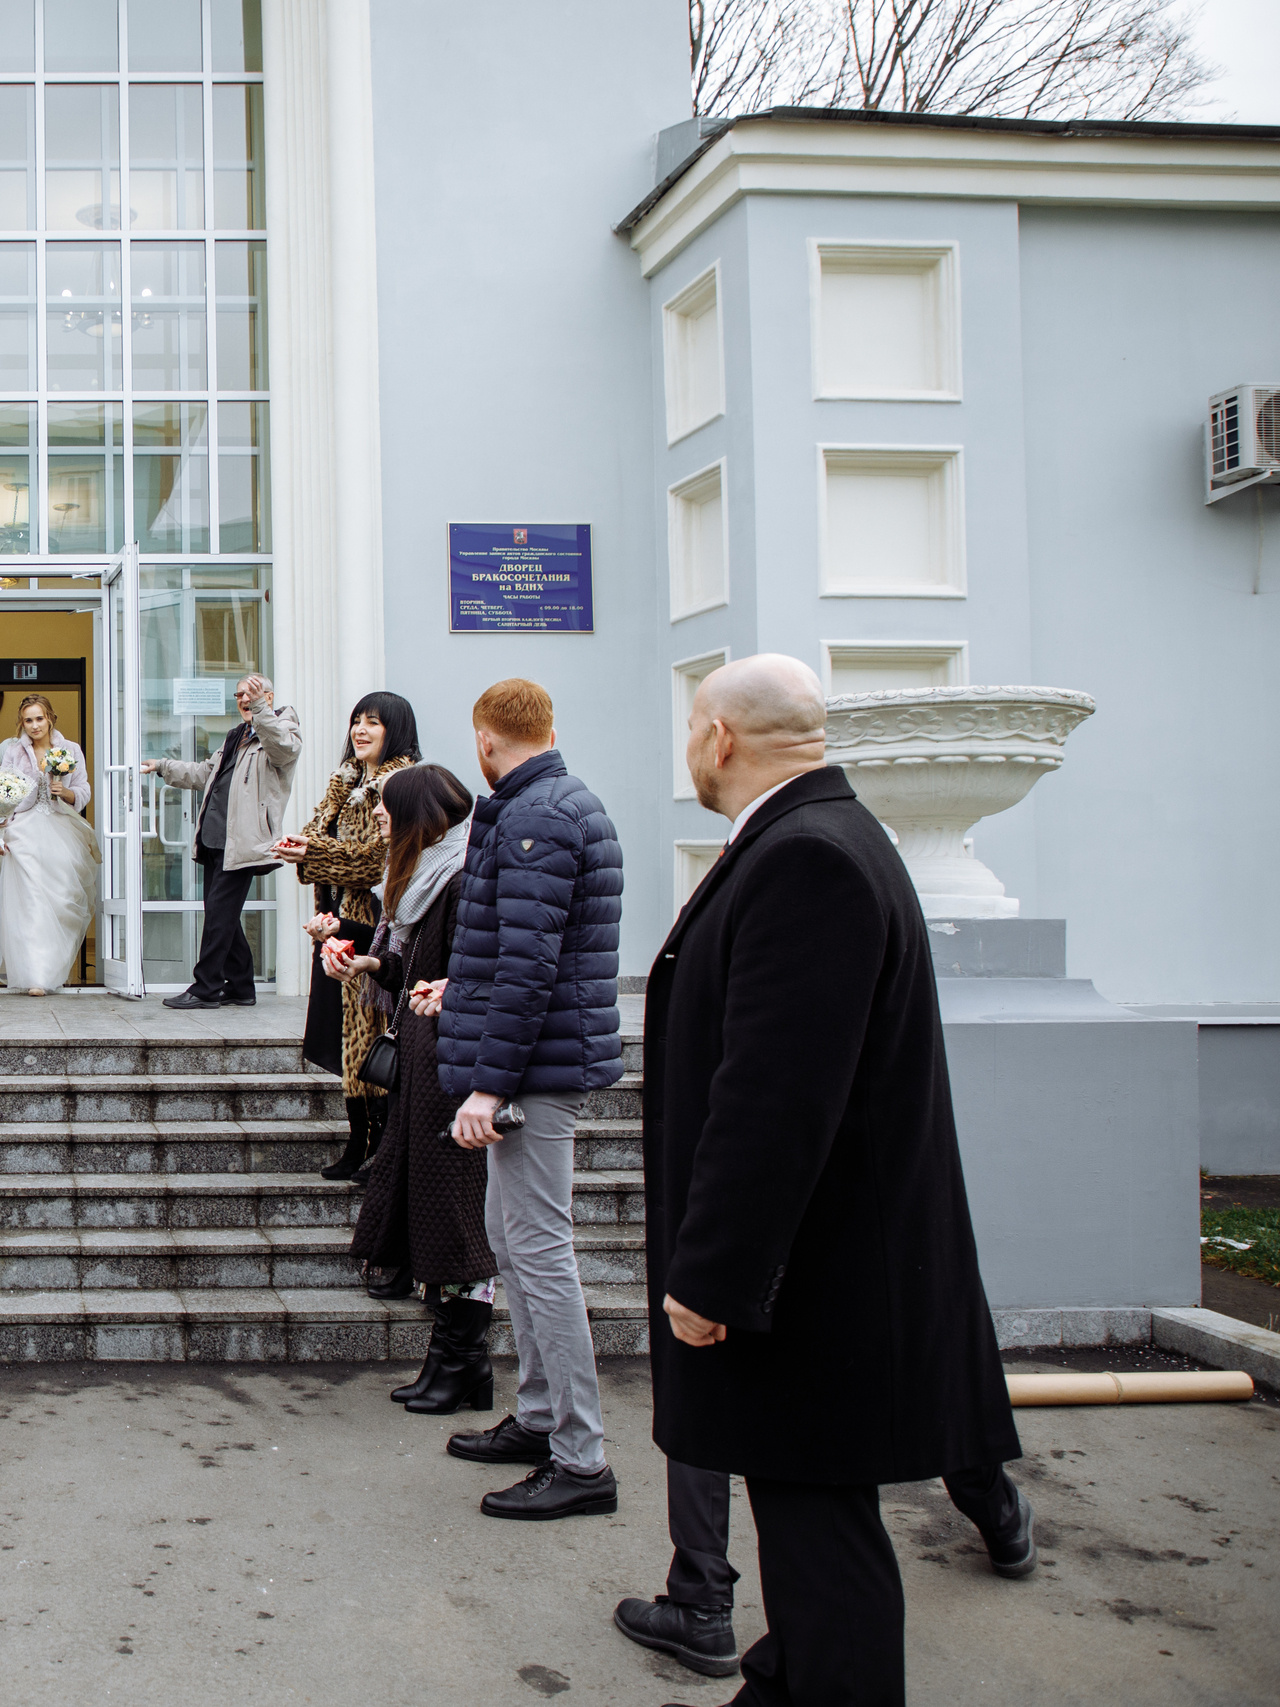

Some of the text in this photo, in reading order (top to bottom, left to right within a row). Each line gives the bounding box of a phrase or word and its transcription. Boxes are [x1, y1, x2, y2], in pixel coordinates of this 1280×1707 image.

[499, 564, 543, 573] ДВОРЕЦ
[472, 573, 570, 582] БРАКОСОЧЕТАНИЯ
[515, 583, 544, 592] ВДНХ
